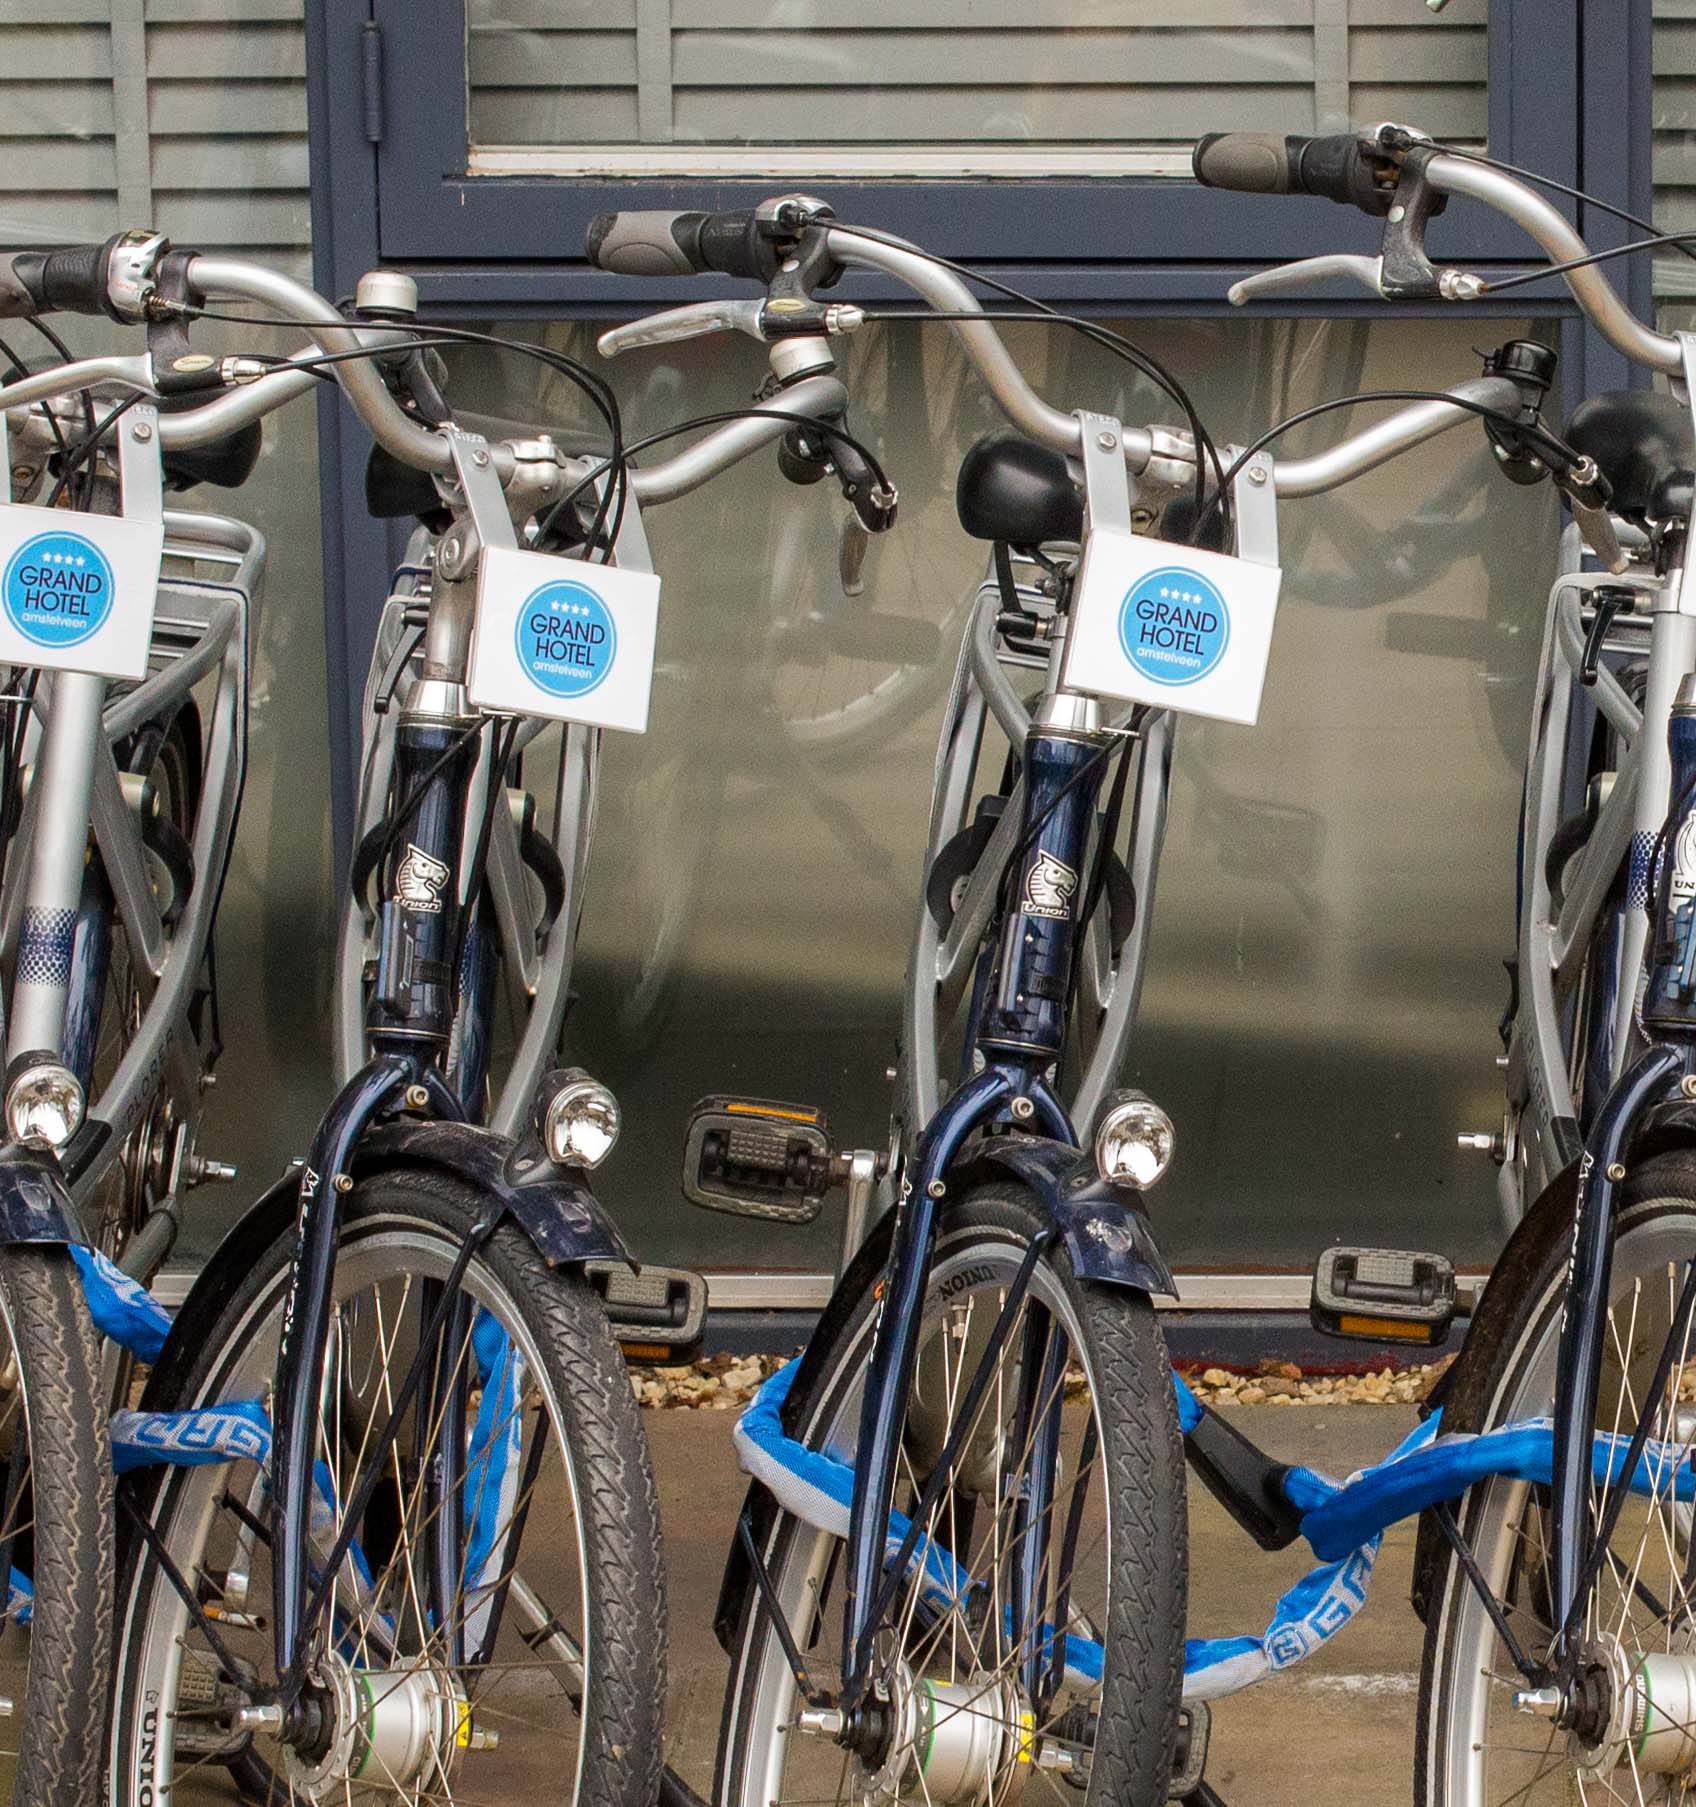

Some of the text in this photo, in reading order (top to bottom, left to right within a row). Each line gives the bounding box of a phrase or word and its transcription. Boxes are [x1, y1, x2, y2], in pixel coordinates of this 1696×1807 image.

[19, 565, 103, 594] GRAND
[25, 589, 90, 616] HOTEL
[1136, 599, 1218, 634] GRAND
[22, 611, 88, 629] amstelveen
[530, 613, 606, 645] GRAND
[535, 637, 596, 667] HOTEL
[1140, 623, 1204, 656] HOTEL
[532, 660, 593, 680] amstelveen
[1136, 647, 1202, 669] amstelveen
[939, 1264, 997, 1301] UNION
